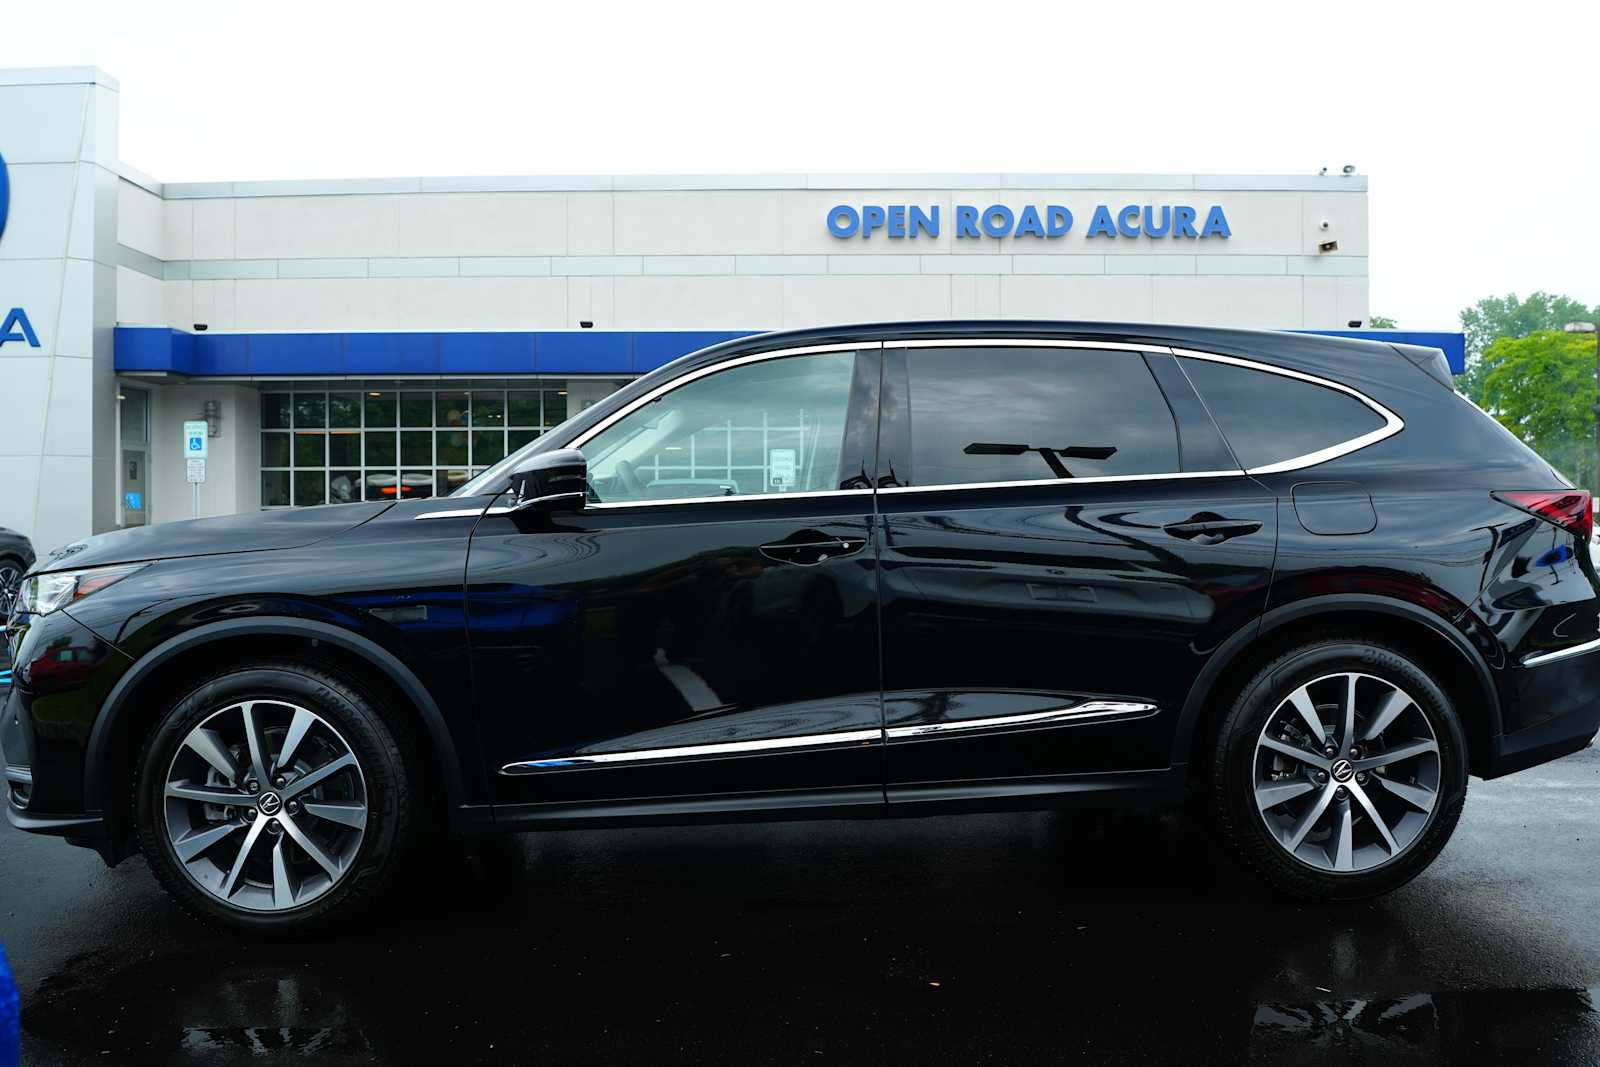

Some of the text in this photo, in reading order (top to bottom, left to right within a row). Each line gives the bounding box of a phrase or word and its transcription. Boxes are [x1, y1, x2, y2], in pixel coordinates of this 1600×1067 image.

[826, 204, 1232, 239] OPEN ROAD ACURA
